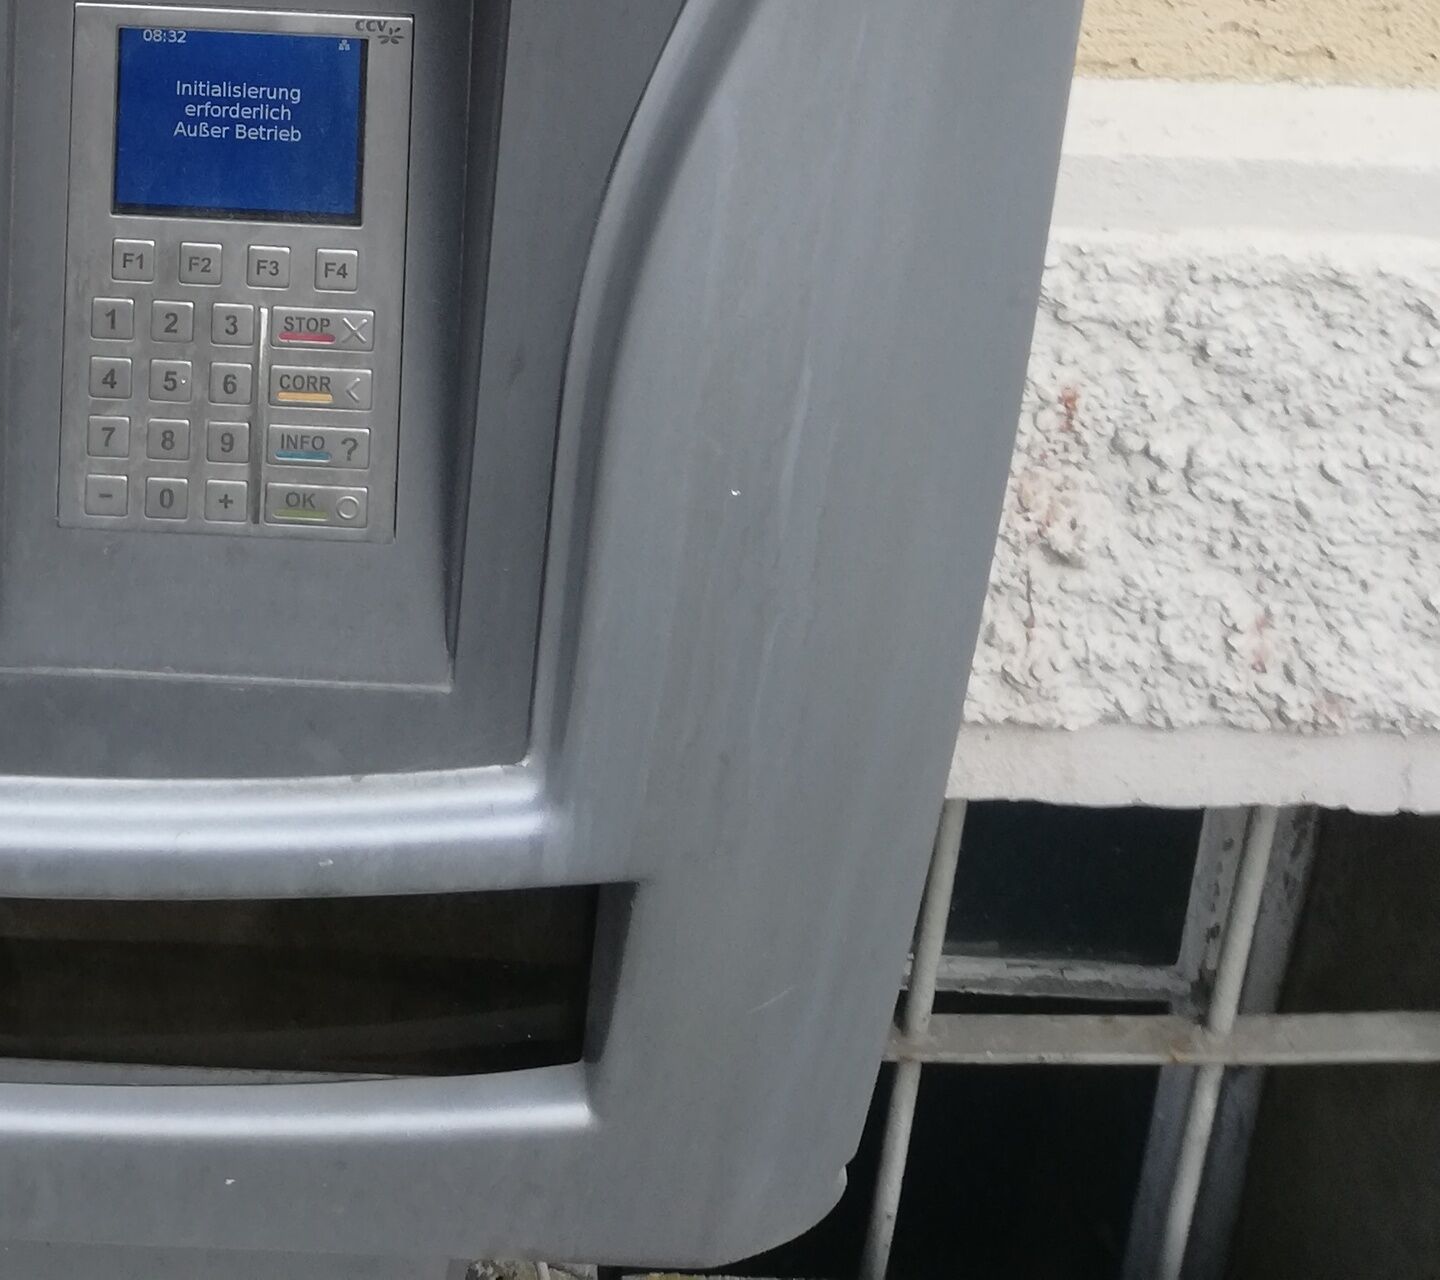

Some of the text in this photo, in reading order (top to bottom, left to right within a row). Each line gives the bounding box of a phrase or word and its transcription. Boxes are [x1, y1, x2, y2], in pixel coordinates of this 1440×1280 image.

[143, 28, 187, 44] 08:32
[176, 80, 302, 104] Initialisierung
[184, 101, 292, 121] erforderlich
[174, 121, 302, 142] Außer Betrieb
[121, 252, 145, 270] F1
[187, 255, 212, 273] F2
[255, 259, 280, 277] F3
[323, 261, 348, 279] F4
[104, 309, 117, 330] 1
[164, 312, 179, 334] 2
[224, 315, 239, 336] 3
[283, 315, 331, 333] STOP
[101, 368, 117, 389] 4
[162, 371, 178, 392] 5
[222, 374, 238, 395] 6
[279, 374, 332, 393] CORR
[101, 426, 116, 448] 7
[160, 429, 176, 451] 8
[220, 432, 235, 453] 9
[280, 433, 360, 462] INFO ?
[159, 488, 174, 510] 0
[285, 491, 316, 510] OK
